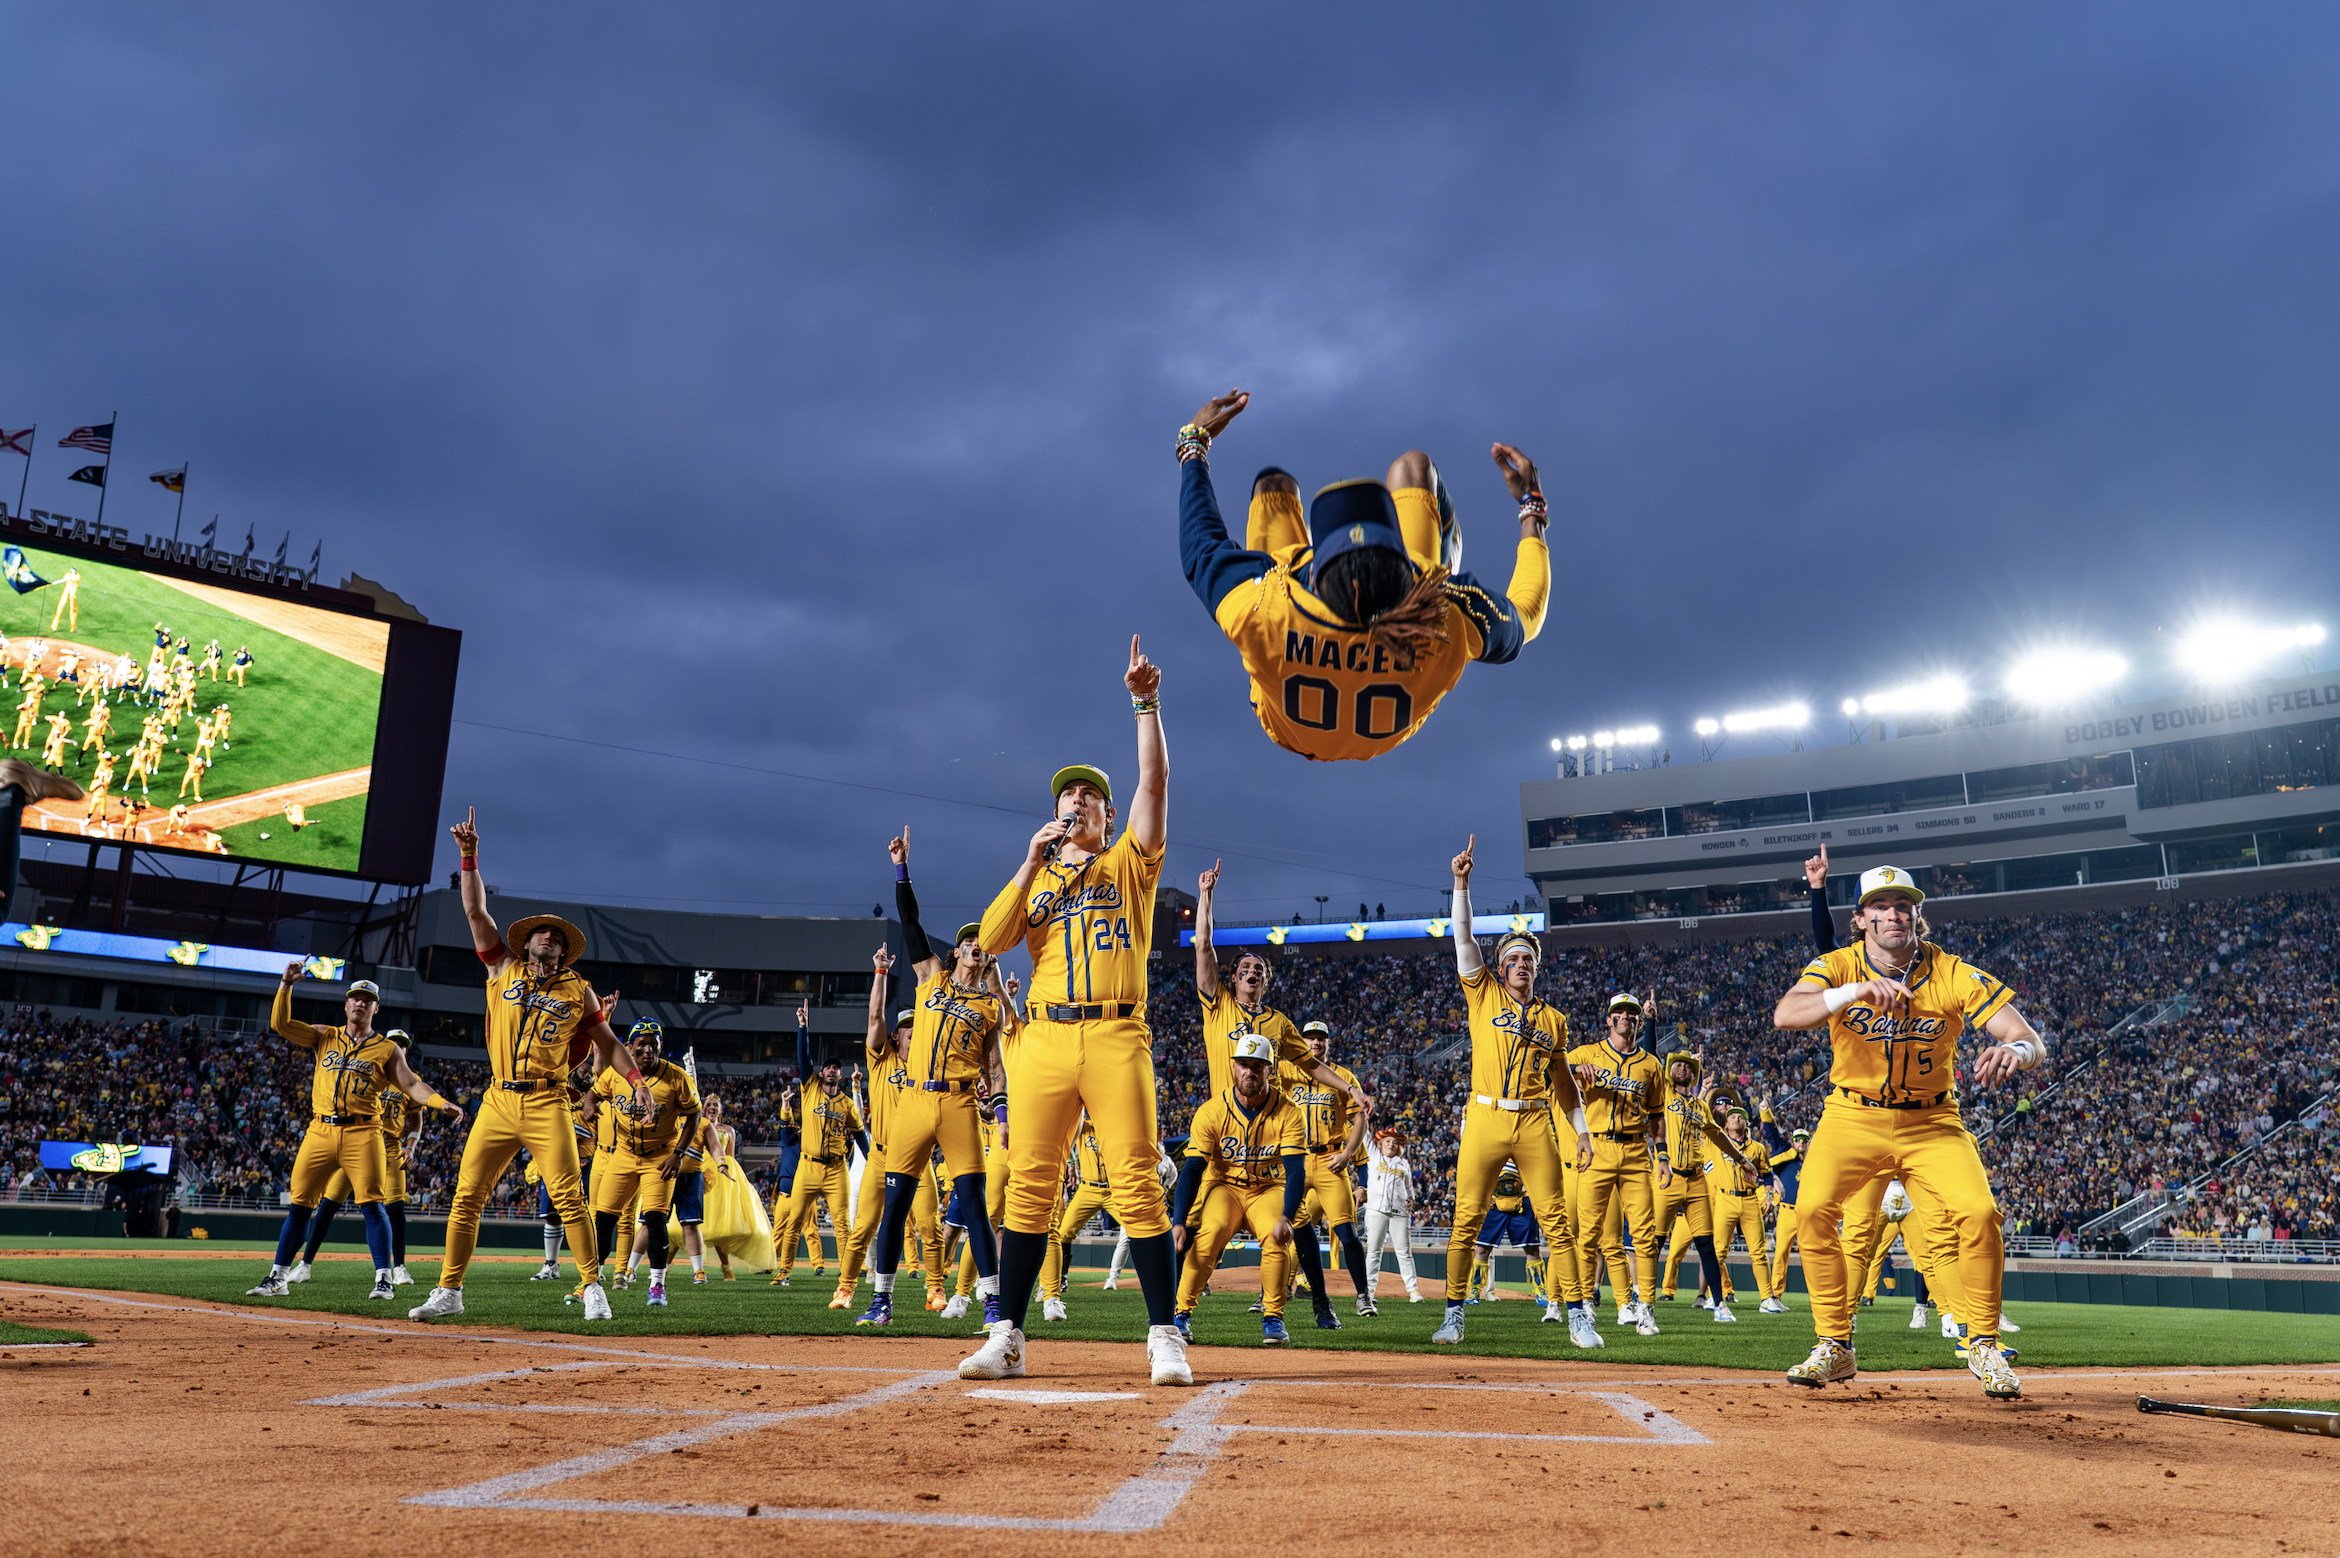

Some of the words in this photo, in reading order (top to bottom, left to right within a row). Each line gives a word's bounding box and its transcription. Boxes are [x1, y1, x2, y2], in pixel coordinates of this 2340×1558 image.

[28, 508, 129, 551] STATE
[143, 533, 317, 591] UNIVERSITY
[1281, 672, 1415, 740] 00
[2065, 715, 2144, 744] BOBBY
[2151, 702, 2259, 732] BOWDEN
[2266, 684, 2340, 714] FIELD
[1993, 809, 2036, 822] SANDERS
[2038, 807, 2046, 816] 2
[2062, 802, 2091, 813] WARD
[2094, 801, 2105, 810] 17
[1847, 826, 1884, 837] SELLERS
[1886, 824, 1899, 833] 34
[1915, 818, 1960, 830] SIMMONS
[1963, 815, 1976, 825] 50
[1701, 841, 1736, 851] BOWDEN
[1763, 832, 1818, 845] BILETNIKOFF
[2155, 878, 2180, 891] 108
[1028, 881, 1124, 930] Bananas
[1093, 917, 1132, 952] 24
[1679, 919, 1699, 930] 106
[1149, 950, 1162, 960] 03
[1284, 945, 1300, 956] 104
[502, 978, 573, 1021] Bananas
[924, 987, 985, 1033] Bananas
[540, 1020, 558, 1044] 2
[1491, 1007, 1554, 1053] Bananas
[1841, 1005, 1949, 1043] Bananas
[961, 1029, 973, 1051] 4
[321, 1050, 375, 1077] Bananas
[1532, 1050, 1542, 1072] 8
[1917, 1047, 1934, 1076] 5
[351, 1077, 371, 1096] 17
[1594, 1067, 1648, 1099] Bananas
[1291, 1086, 1337, 1107] Bananas
[385, 1104, 400, 1120] 18
[1320, 1108, 1337, 1126] 44
[1630, 1098, 1641, 1117] 3
[651, 1117, 661, 1132] 7
[1219, 1136, 1282, 1164] Bananas
